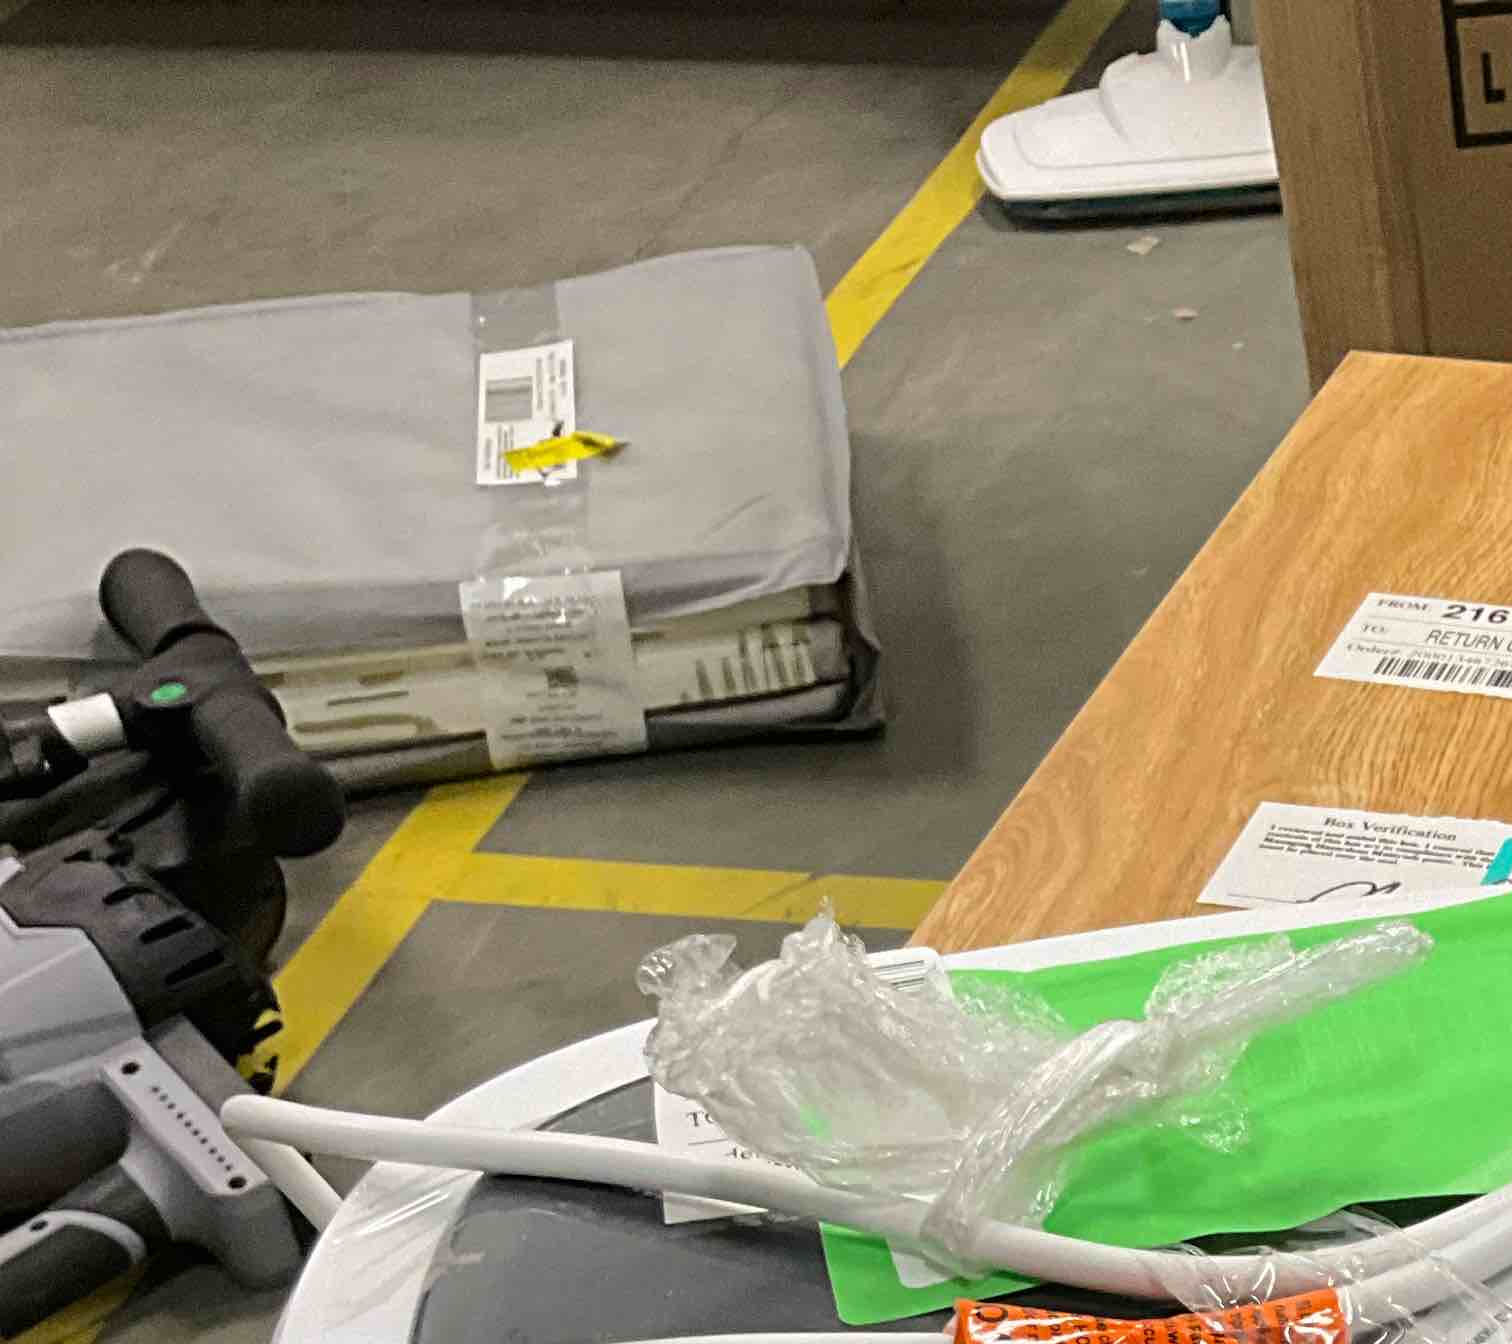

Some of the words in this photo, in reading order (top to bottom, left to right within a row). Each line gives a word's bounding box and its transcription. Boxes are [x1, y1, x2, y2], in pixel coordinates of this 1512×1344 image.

[1481, 50, 1504, 103] L
[1425, 629, 1504, 652] RETURN
[1362, 821, 1457, 842] Verification
